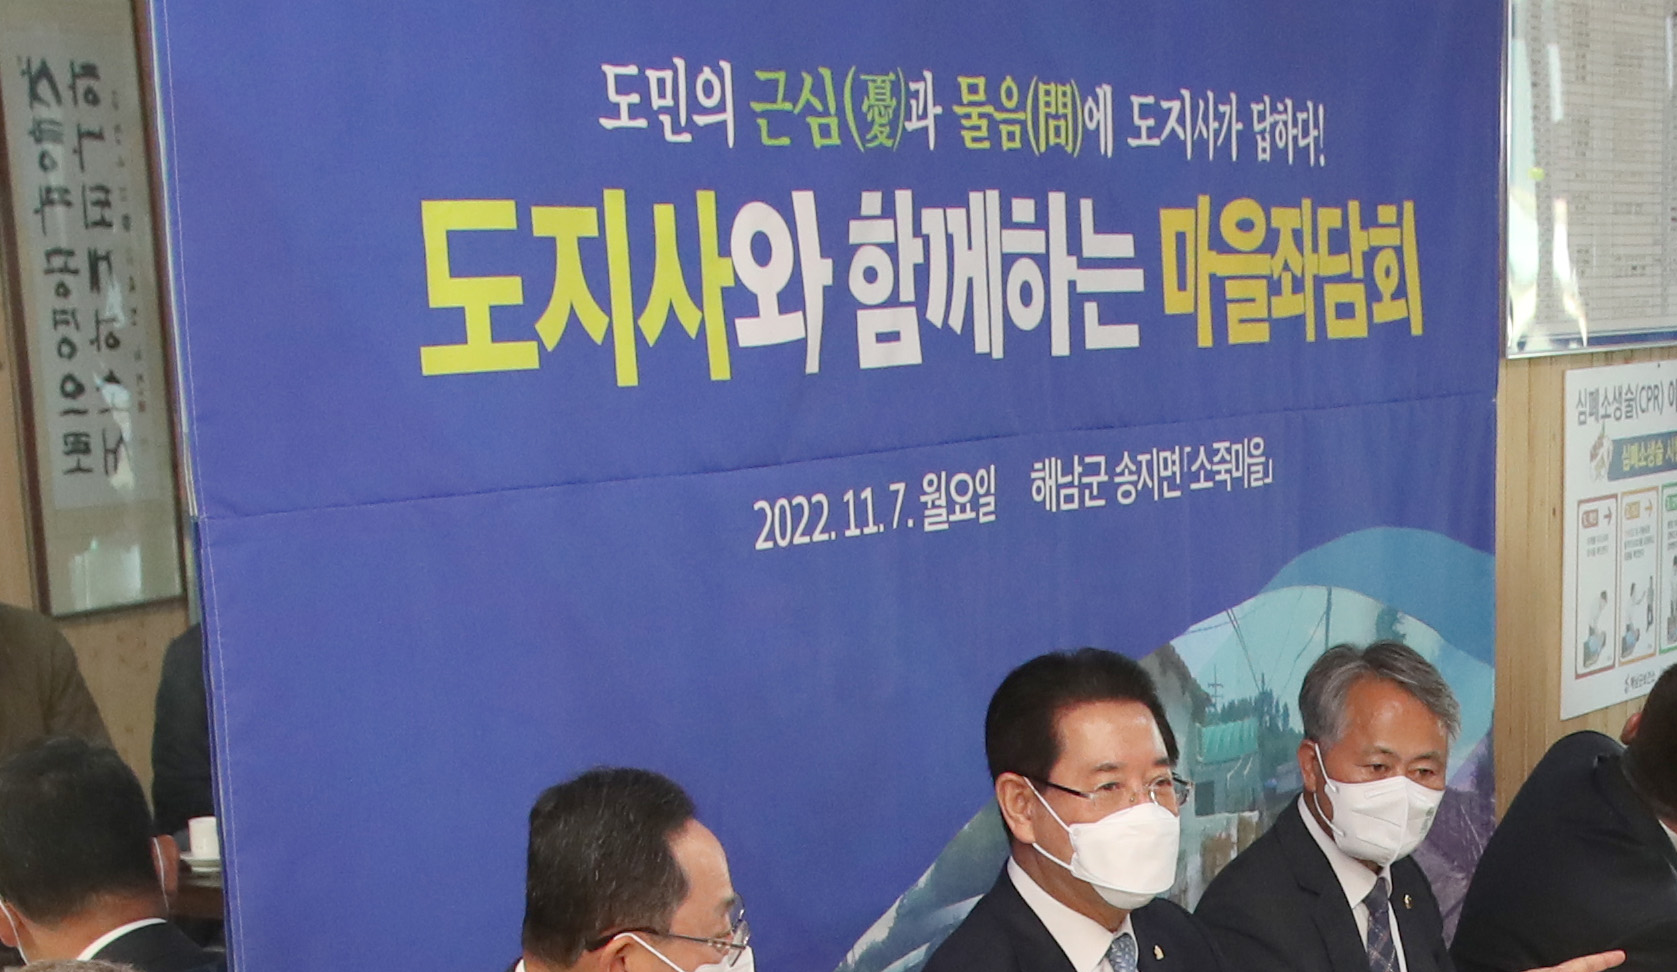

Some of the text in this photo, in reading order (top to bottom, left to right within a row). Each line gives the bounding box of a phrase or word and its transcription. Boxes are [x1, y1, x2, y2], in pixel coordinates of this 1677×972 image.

[599, 56, 1326, 168] 도민의 근심(憂)과 물음(問)에 도지사가 답하다!
[420, 188, 1423, 388] 도지사와 함께하는 마을좌담회
[1576, 381, 1664, 426] 심폐소생술(CPR)
[920, 464, 996, 532] 월요일
[1030, 455, 1109, 512] 해남군
[1622, 440, 1663, 471] 심폐소생술
